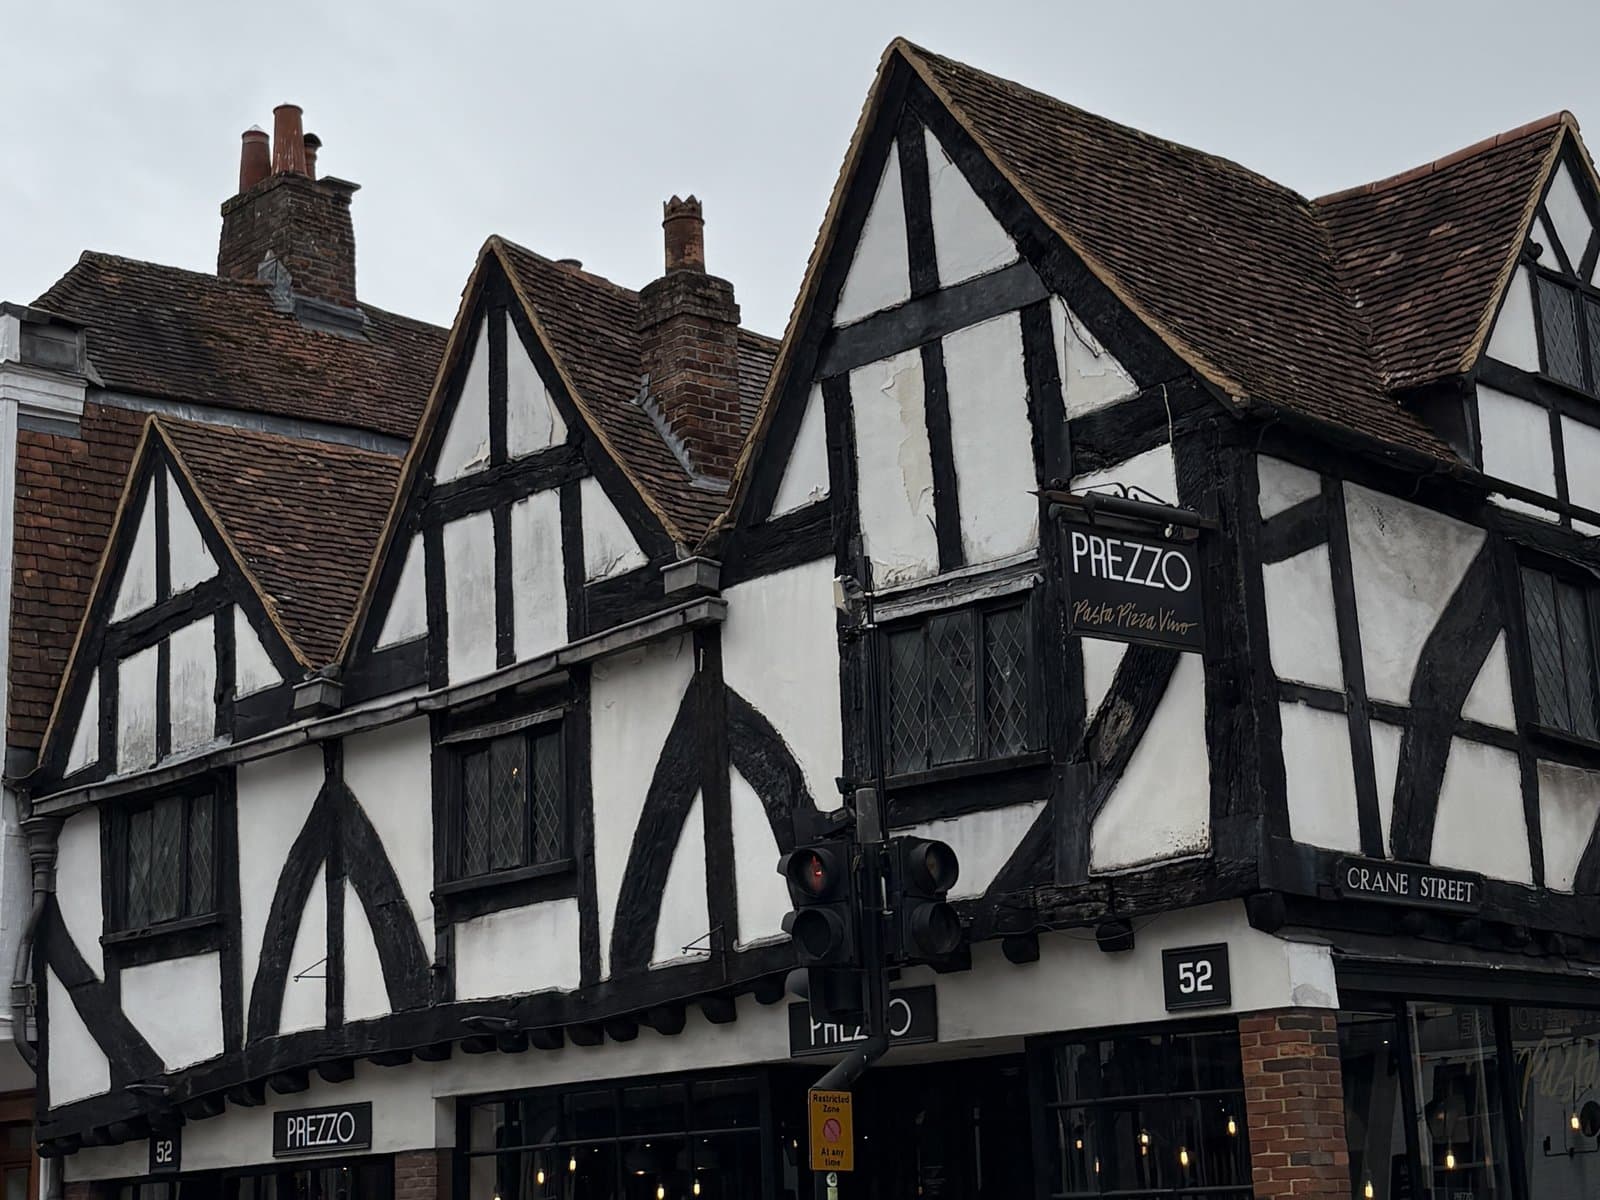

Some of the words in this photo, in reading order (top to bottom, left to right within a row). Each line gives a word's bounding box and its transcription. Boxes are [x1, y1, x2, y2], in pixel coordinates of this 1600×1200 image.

[1071, 531, 1192, 592] PREZZO
[1073, 599, 1115, 625] Pasta
[1117, 602, 1157, 632] Pizza
[1159, 607, 1199, 636] Vino
[1347, 867, 1409, 895] CRANE
[1420, 876, 1474, 903] STREET
[1178, 959, 1214, 994] 52
[809, 998, 912, 1046] PRO
[813, 1094, 850, 1104] Restricted
[823, 1105, 840, 1113] Zone
[286, 1111, 356, 1148] PREZZO
[156, 1140, 173, 1163] 52
[821, 1147, 830, 1156] At
[832, 1149, 845, 1158] any
[825, 1158, 841, 1167] time
